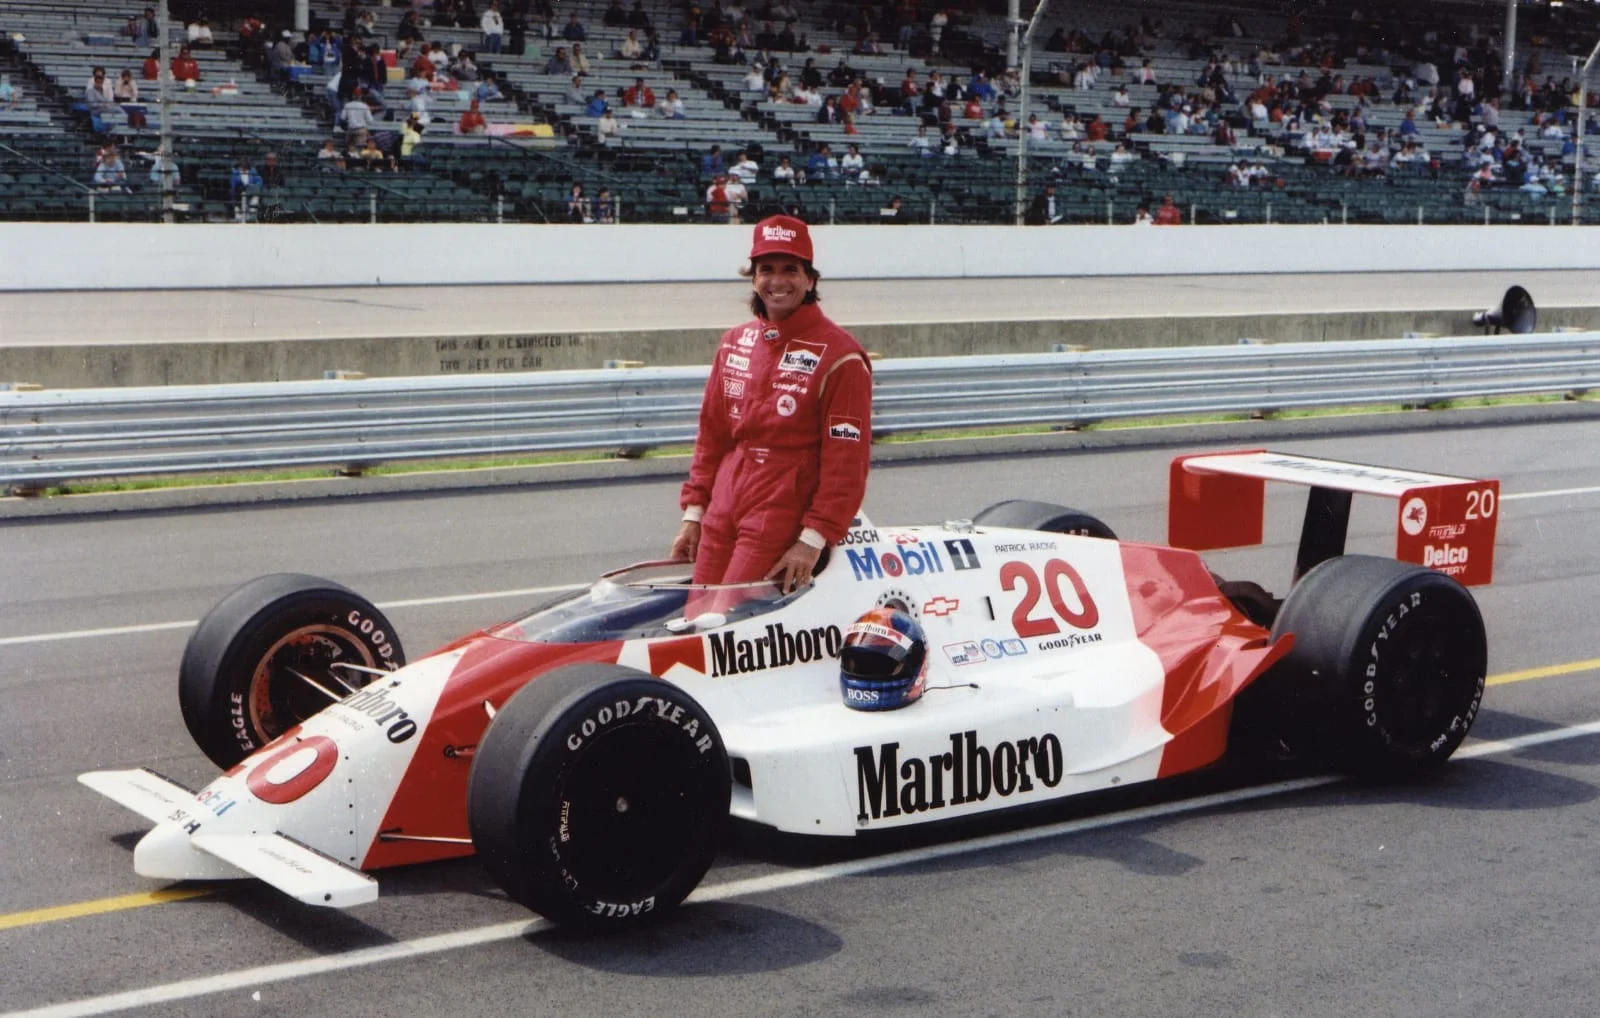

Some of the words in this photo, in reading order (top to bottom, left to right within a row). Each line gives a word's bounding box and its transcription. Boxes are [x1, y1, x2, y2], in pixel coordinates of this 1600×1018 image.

[763, 225, 797, 238] Marlboro
[783, 353, 818, 368] Marlboro
[831, 427, 860, 440] Marlboro
[1464, 489, 1495, 520] 20
[845, 541, 945, 581] Mobil
[995, 543, 1027, 554] PATRICK
[1029, 541, 1058, 552] RACING
[1423, 543, 1469, 567] Delco
[999, 558, 1100, 639] 20
[348, 610, 395, 660] GOOD
[708, 623, 842, 678] Marlboro
[1039, 633, 1103, 651] GOODYEAR
[1364, 592, 1421, 726] GOODYEAR
[847, 688, 880, 701] BOSS
[231, 692, 255, 751] EAGLE
[342, 688, 417, 744] rlboro
[567, 696, 713, 754] GOODYEAR
[243, 735, 339, 804] 0
[854, 730, 1063, 823] Marlboro
[592, 896, 656, 917] EAGLE
